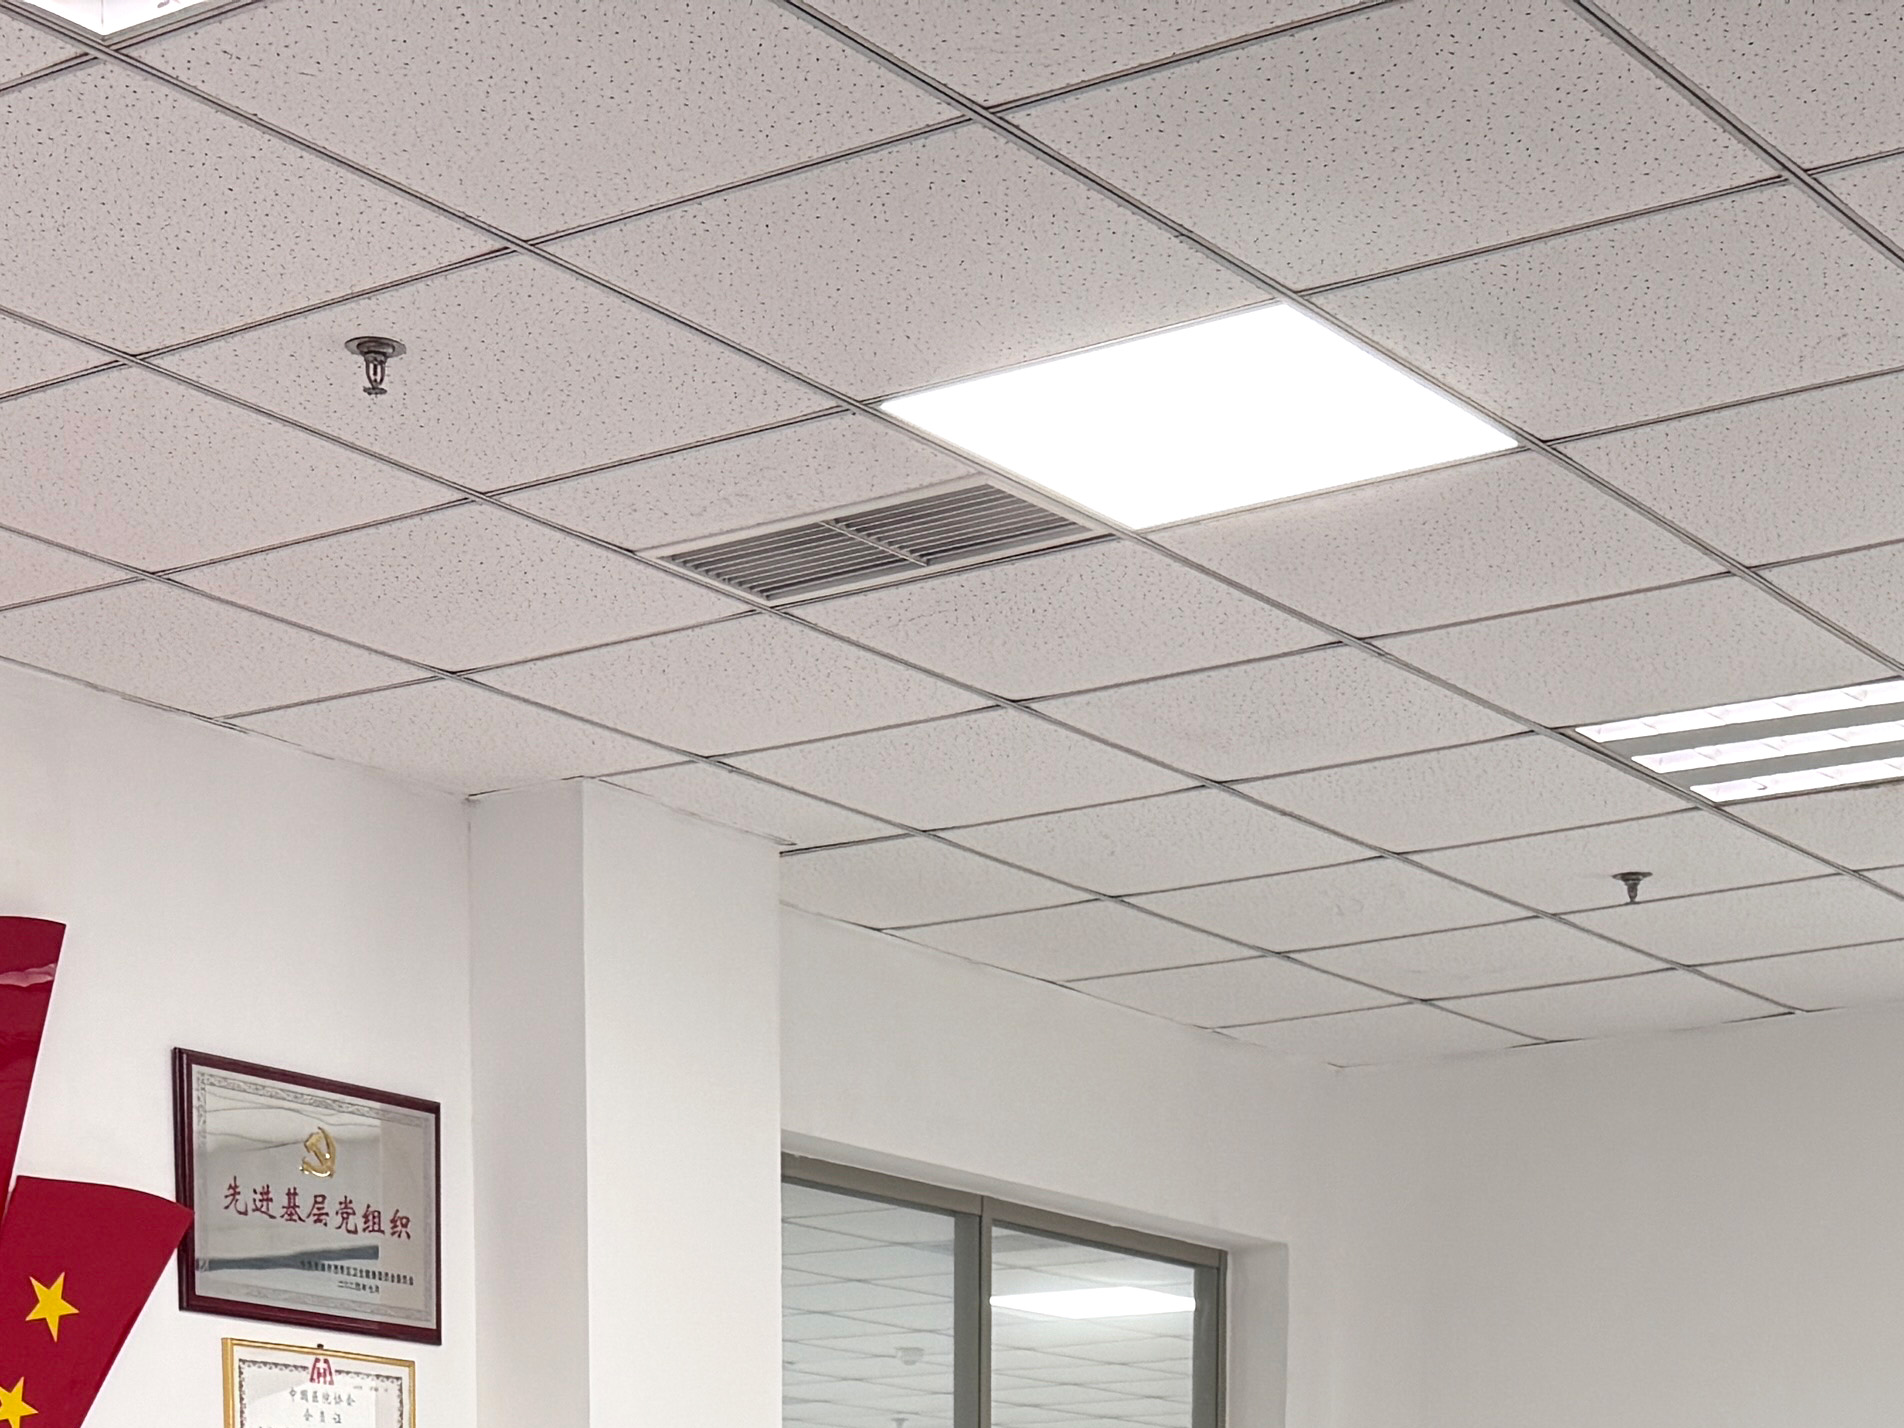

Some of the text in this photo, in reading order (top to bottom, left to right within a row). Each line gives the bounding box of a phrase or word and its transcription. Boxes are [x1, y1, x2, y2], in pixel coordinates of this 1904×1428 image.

[223, 1175, 412, 1240] 先进基层党组织
